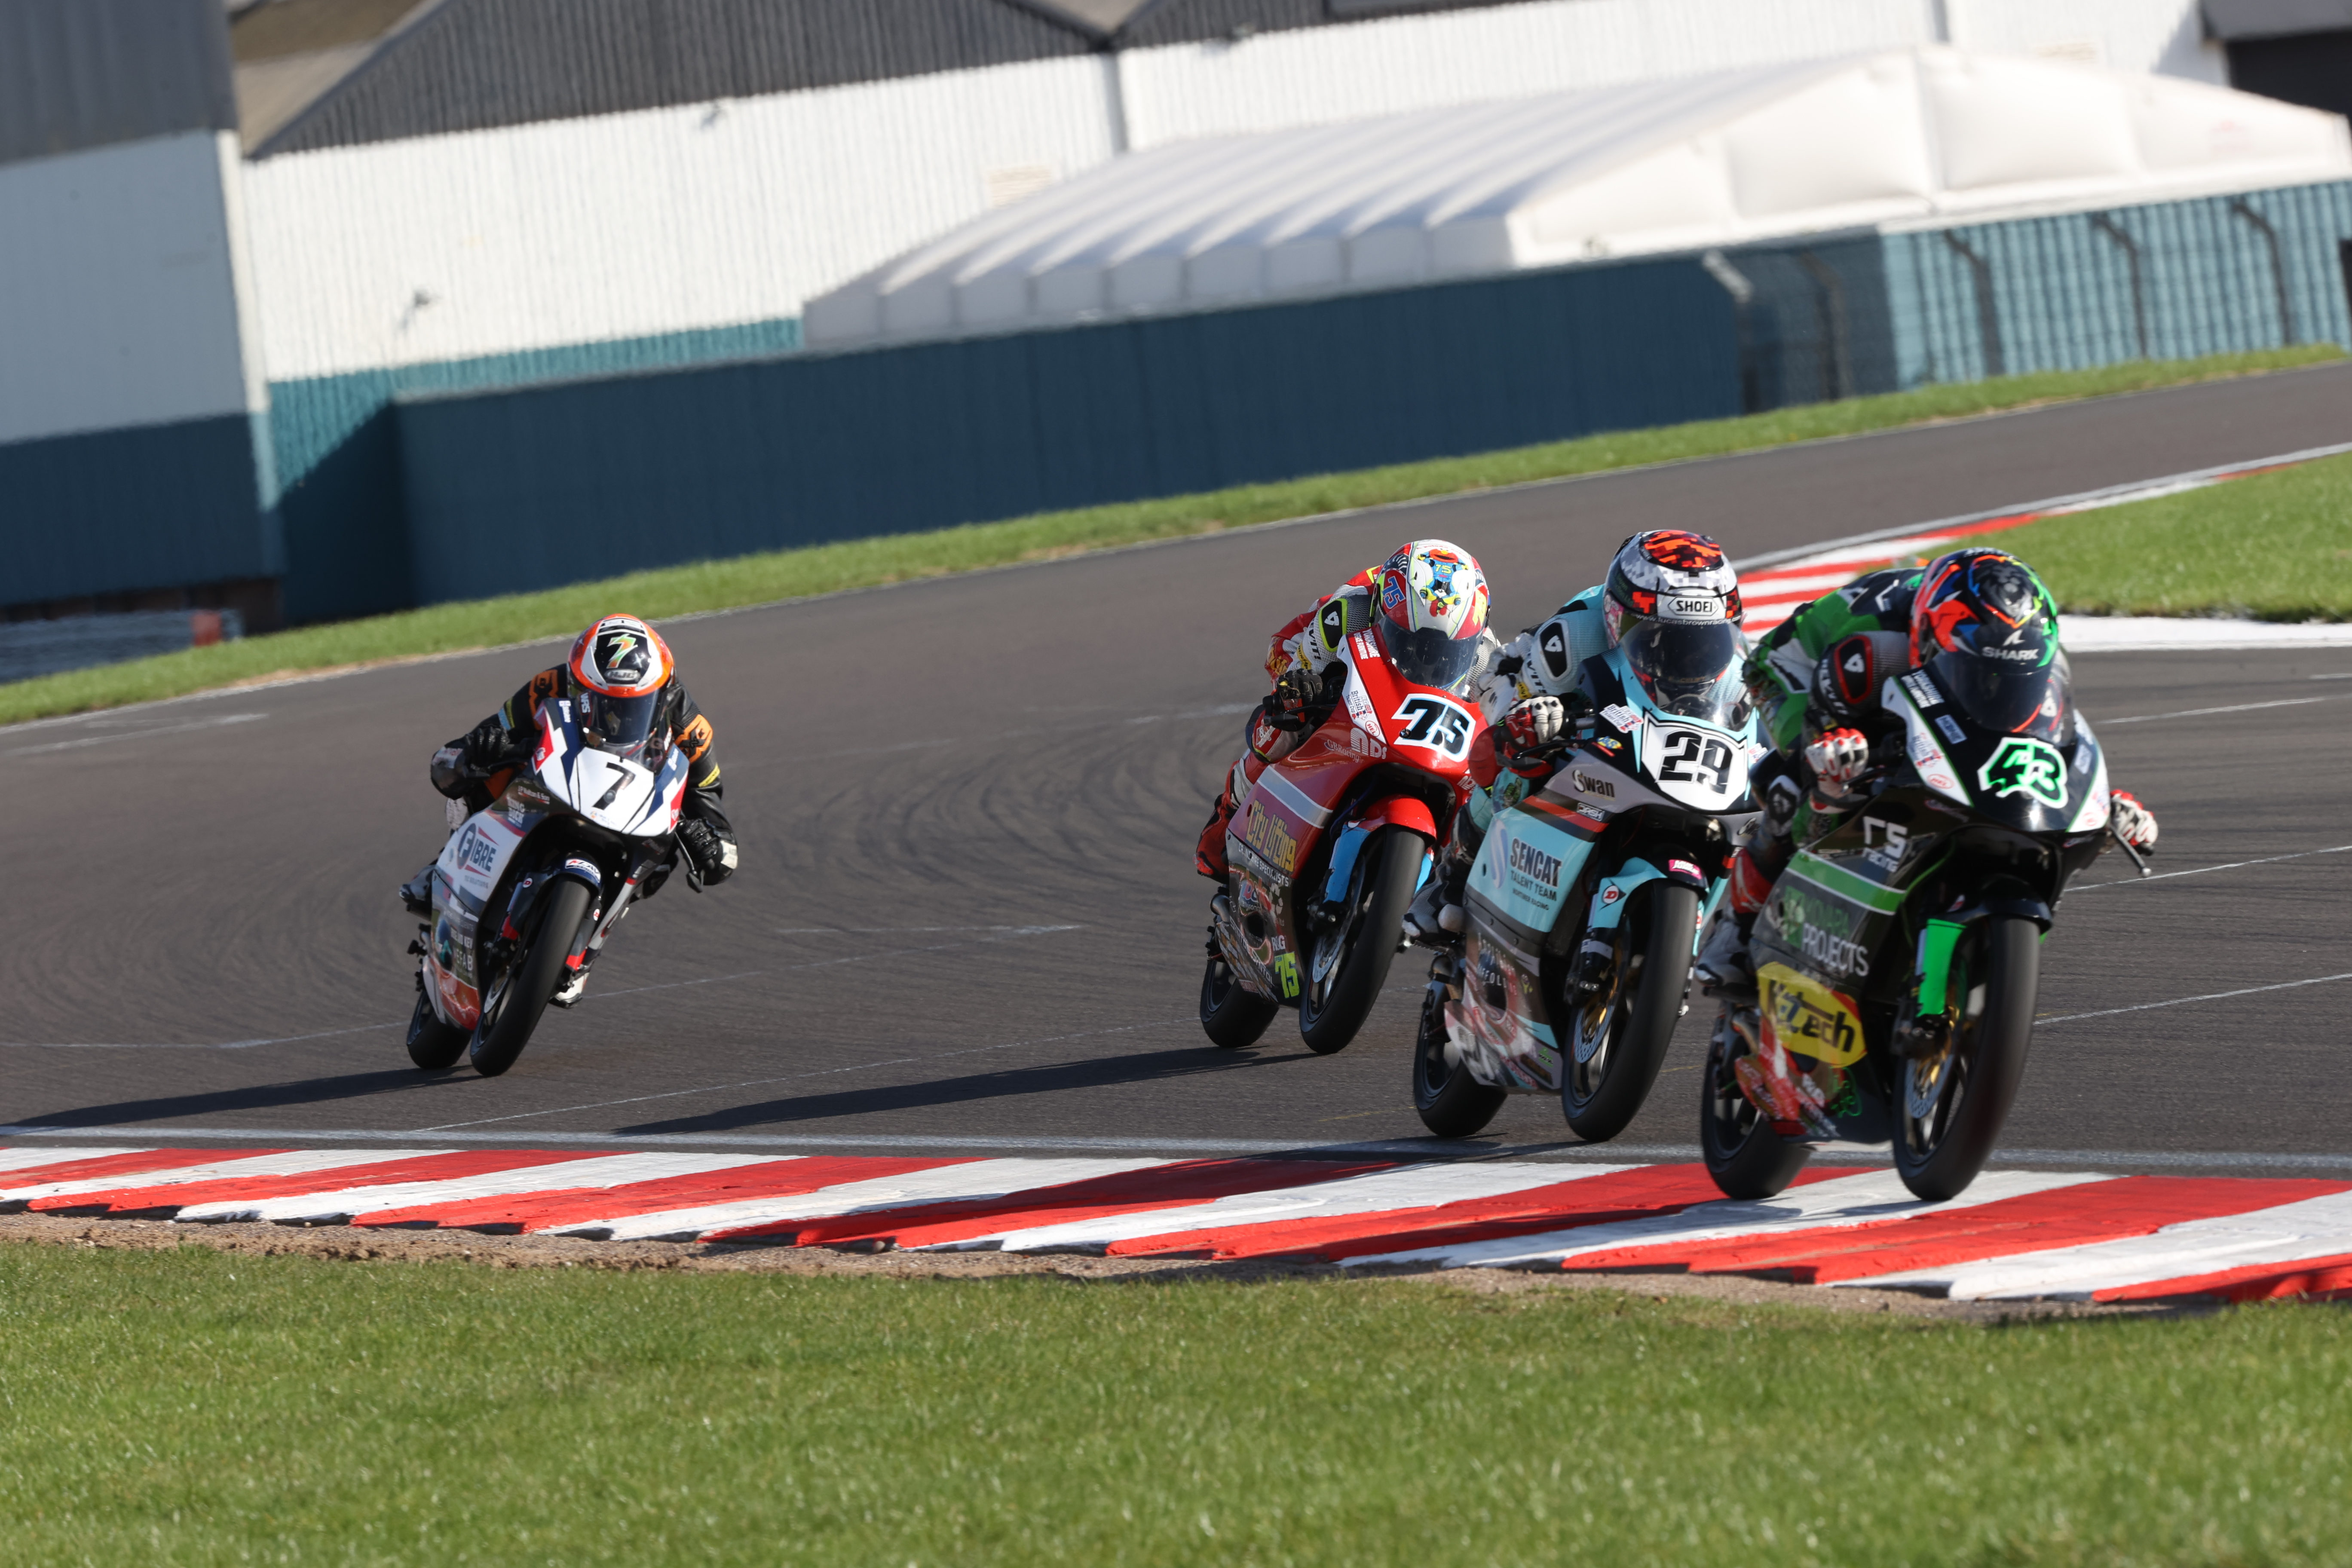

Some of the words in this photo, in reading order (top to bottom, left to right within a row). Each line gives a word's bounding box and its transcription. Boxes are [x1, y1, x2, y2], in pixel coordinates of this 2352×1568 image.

[1435, 564, 1452, 574] 75
[1382, 576, 1406, 609] 75
[1676, 600, 1712, 612] SHOEI
[1363, 628, 1380, 658] YORKSHIRE
[1982, 646, 2039, 661] SHARK
[1351, 690, 1364, 710] British
[1610, 704, 1629, 723] British
[1367, 724, 1377, 735] HEL
[1401, 698, 1470, 755] 75
[1326, 739, 1360, 763] GBRacing
[1657, 730, 1733, 795] 29
[592, 762, 637, 811] 7
[1572, 769, 1615, 798] Swan
[1983, 740, 2064, 804] 43
[457, 829, 496, 873] FIBRE
[1246, 799, 1269, 851] City
[1262, 814, 1297, 873] Lifting
[1259, 861, 1289, 887] SPECIALISTS
[1510, 838, 1562, 888] SENCAT
[1511, 870, 1533, 891] TALENT
[1534, 883, 1557, 901] TEAM
[1801, 922, 1869, 977] PROJECTS
[1274, 951, 1300, 998] 75
